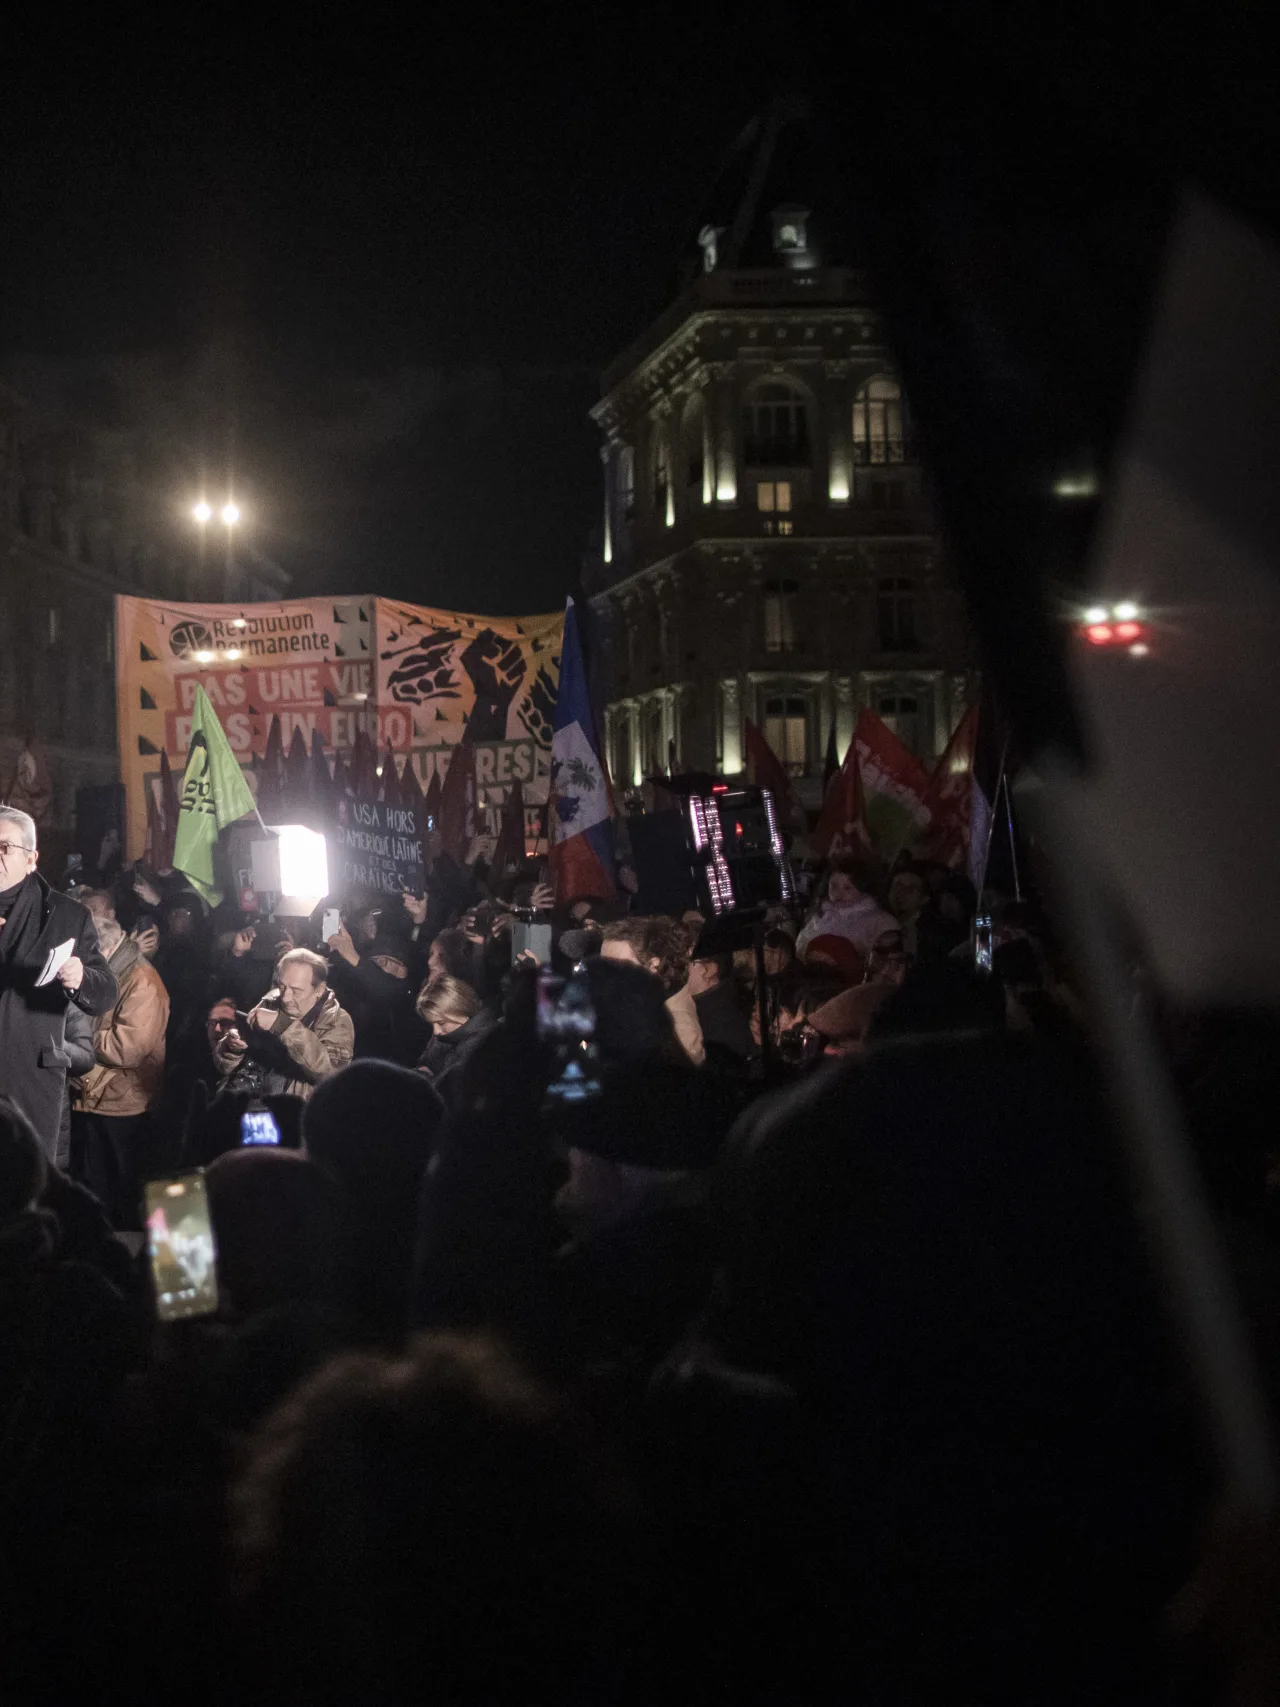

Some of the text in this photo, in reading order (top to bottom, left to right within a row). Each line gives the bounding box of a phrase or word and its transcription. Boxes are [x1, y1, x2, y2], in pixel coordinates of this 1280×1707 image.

[180, 664, 371, 709] PAS UNE VIE
[175, 712, 252, 752] PS
[353, 804, 416, 834] USA HORS
